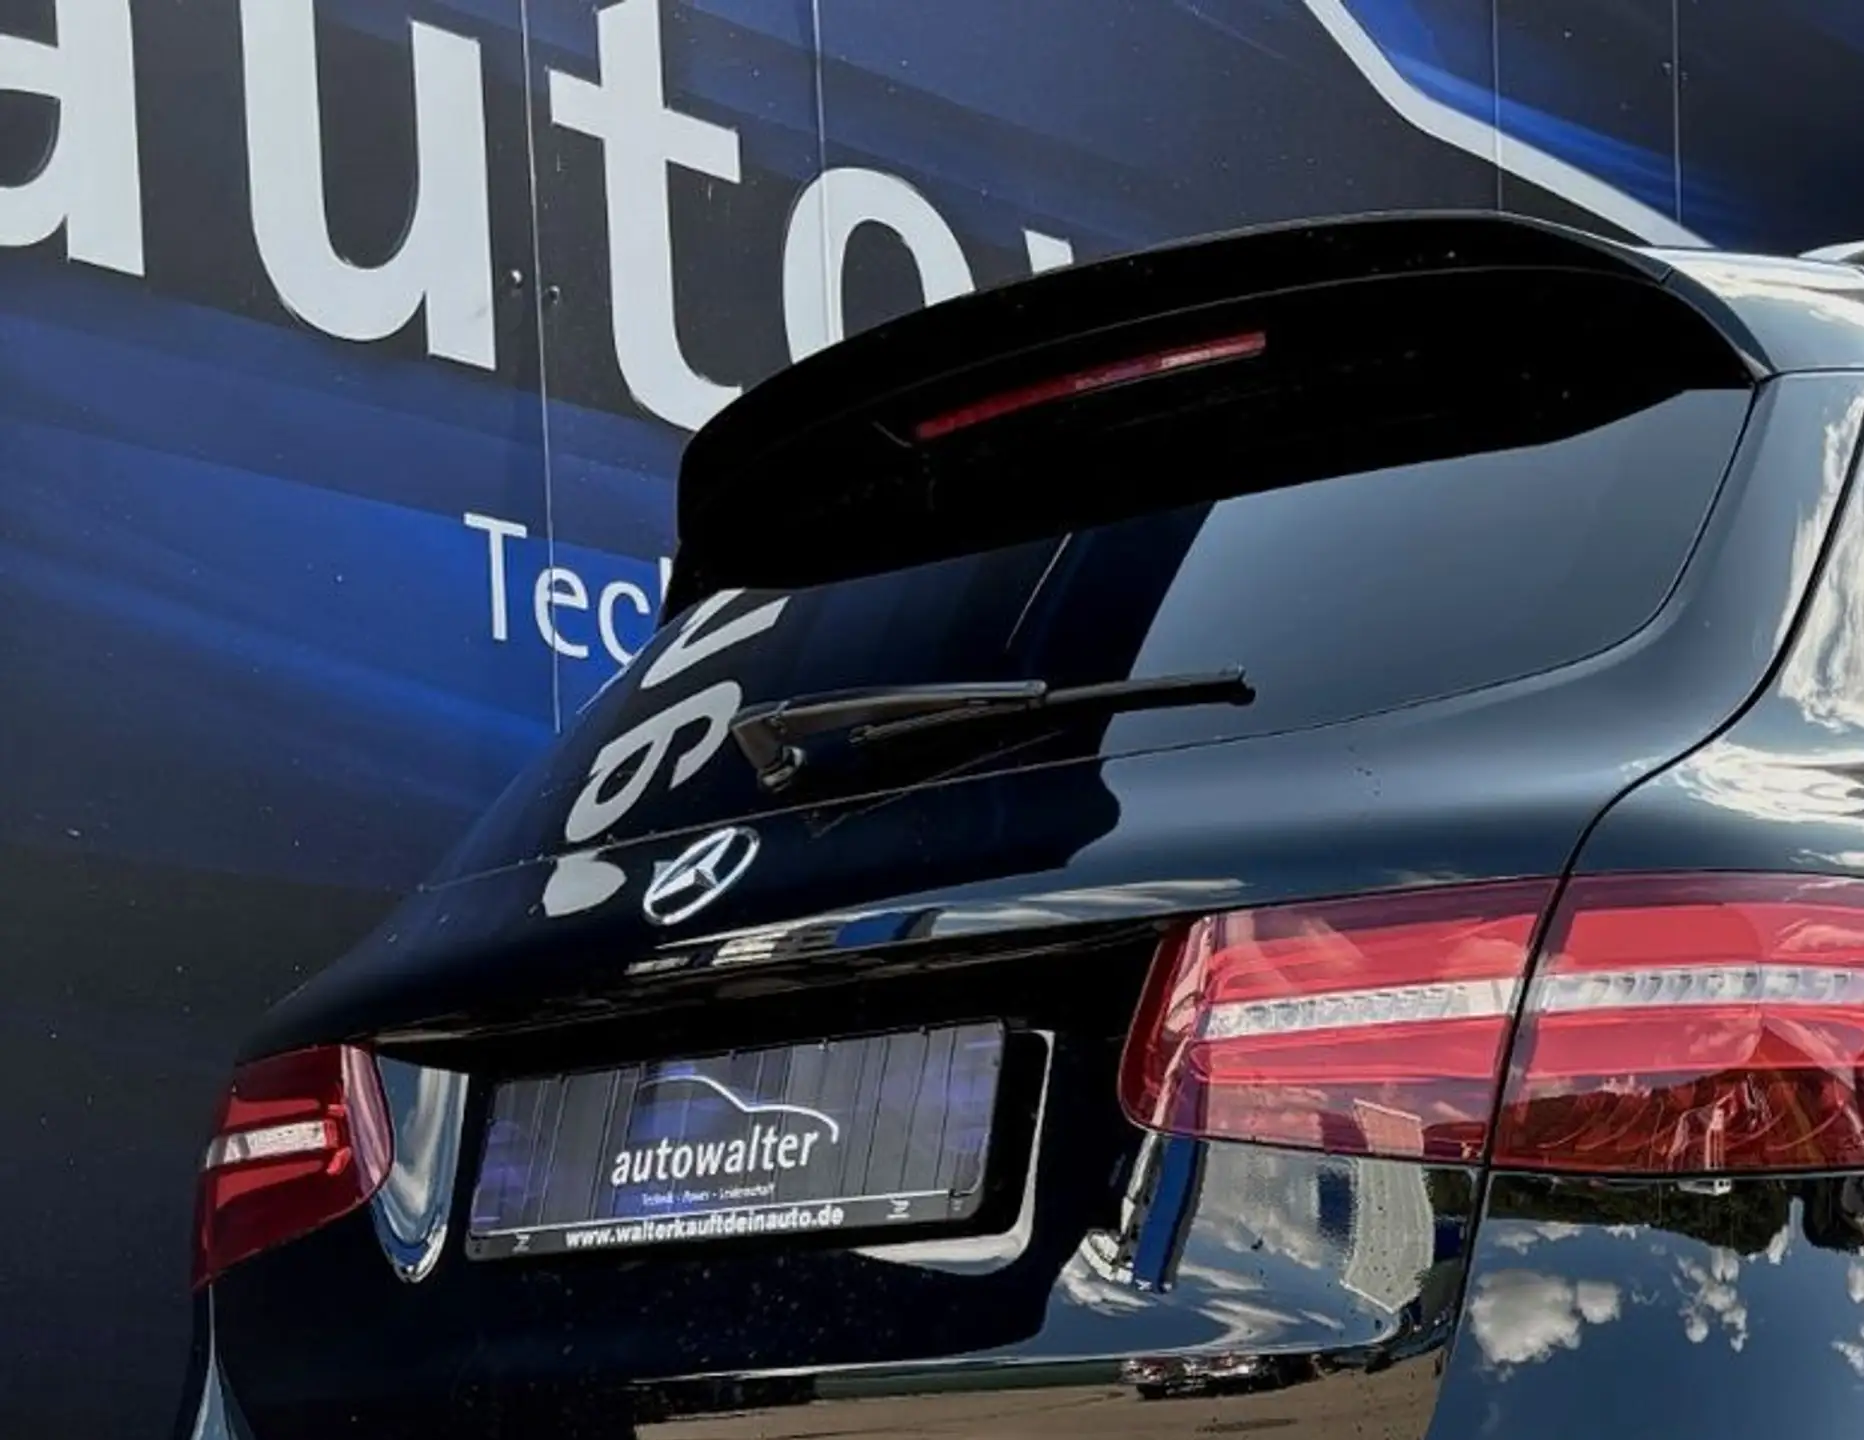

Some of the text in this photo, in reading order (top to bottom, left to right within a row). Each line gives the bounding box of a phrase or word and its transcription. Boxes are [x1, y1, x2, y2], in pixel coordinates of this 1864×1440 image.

[463, 512, 674, 666] Tec
[610, 1123, 820, 1188] autowalter
[564, 1203, 845, 1248] www.walterkauftdeinauto.de
